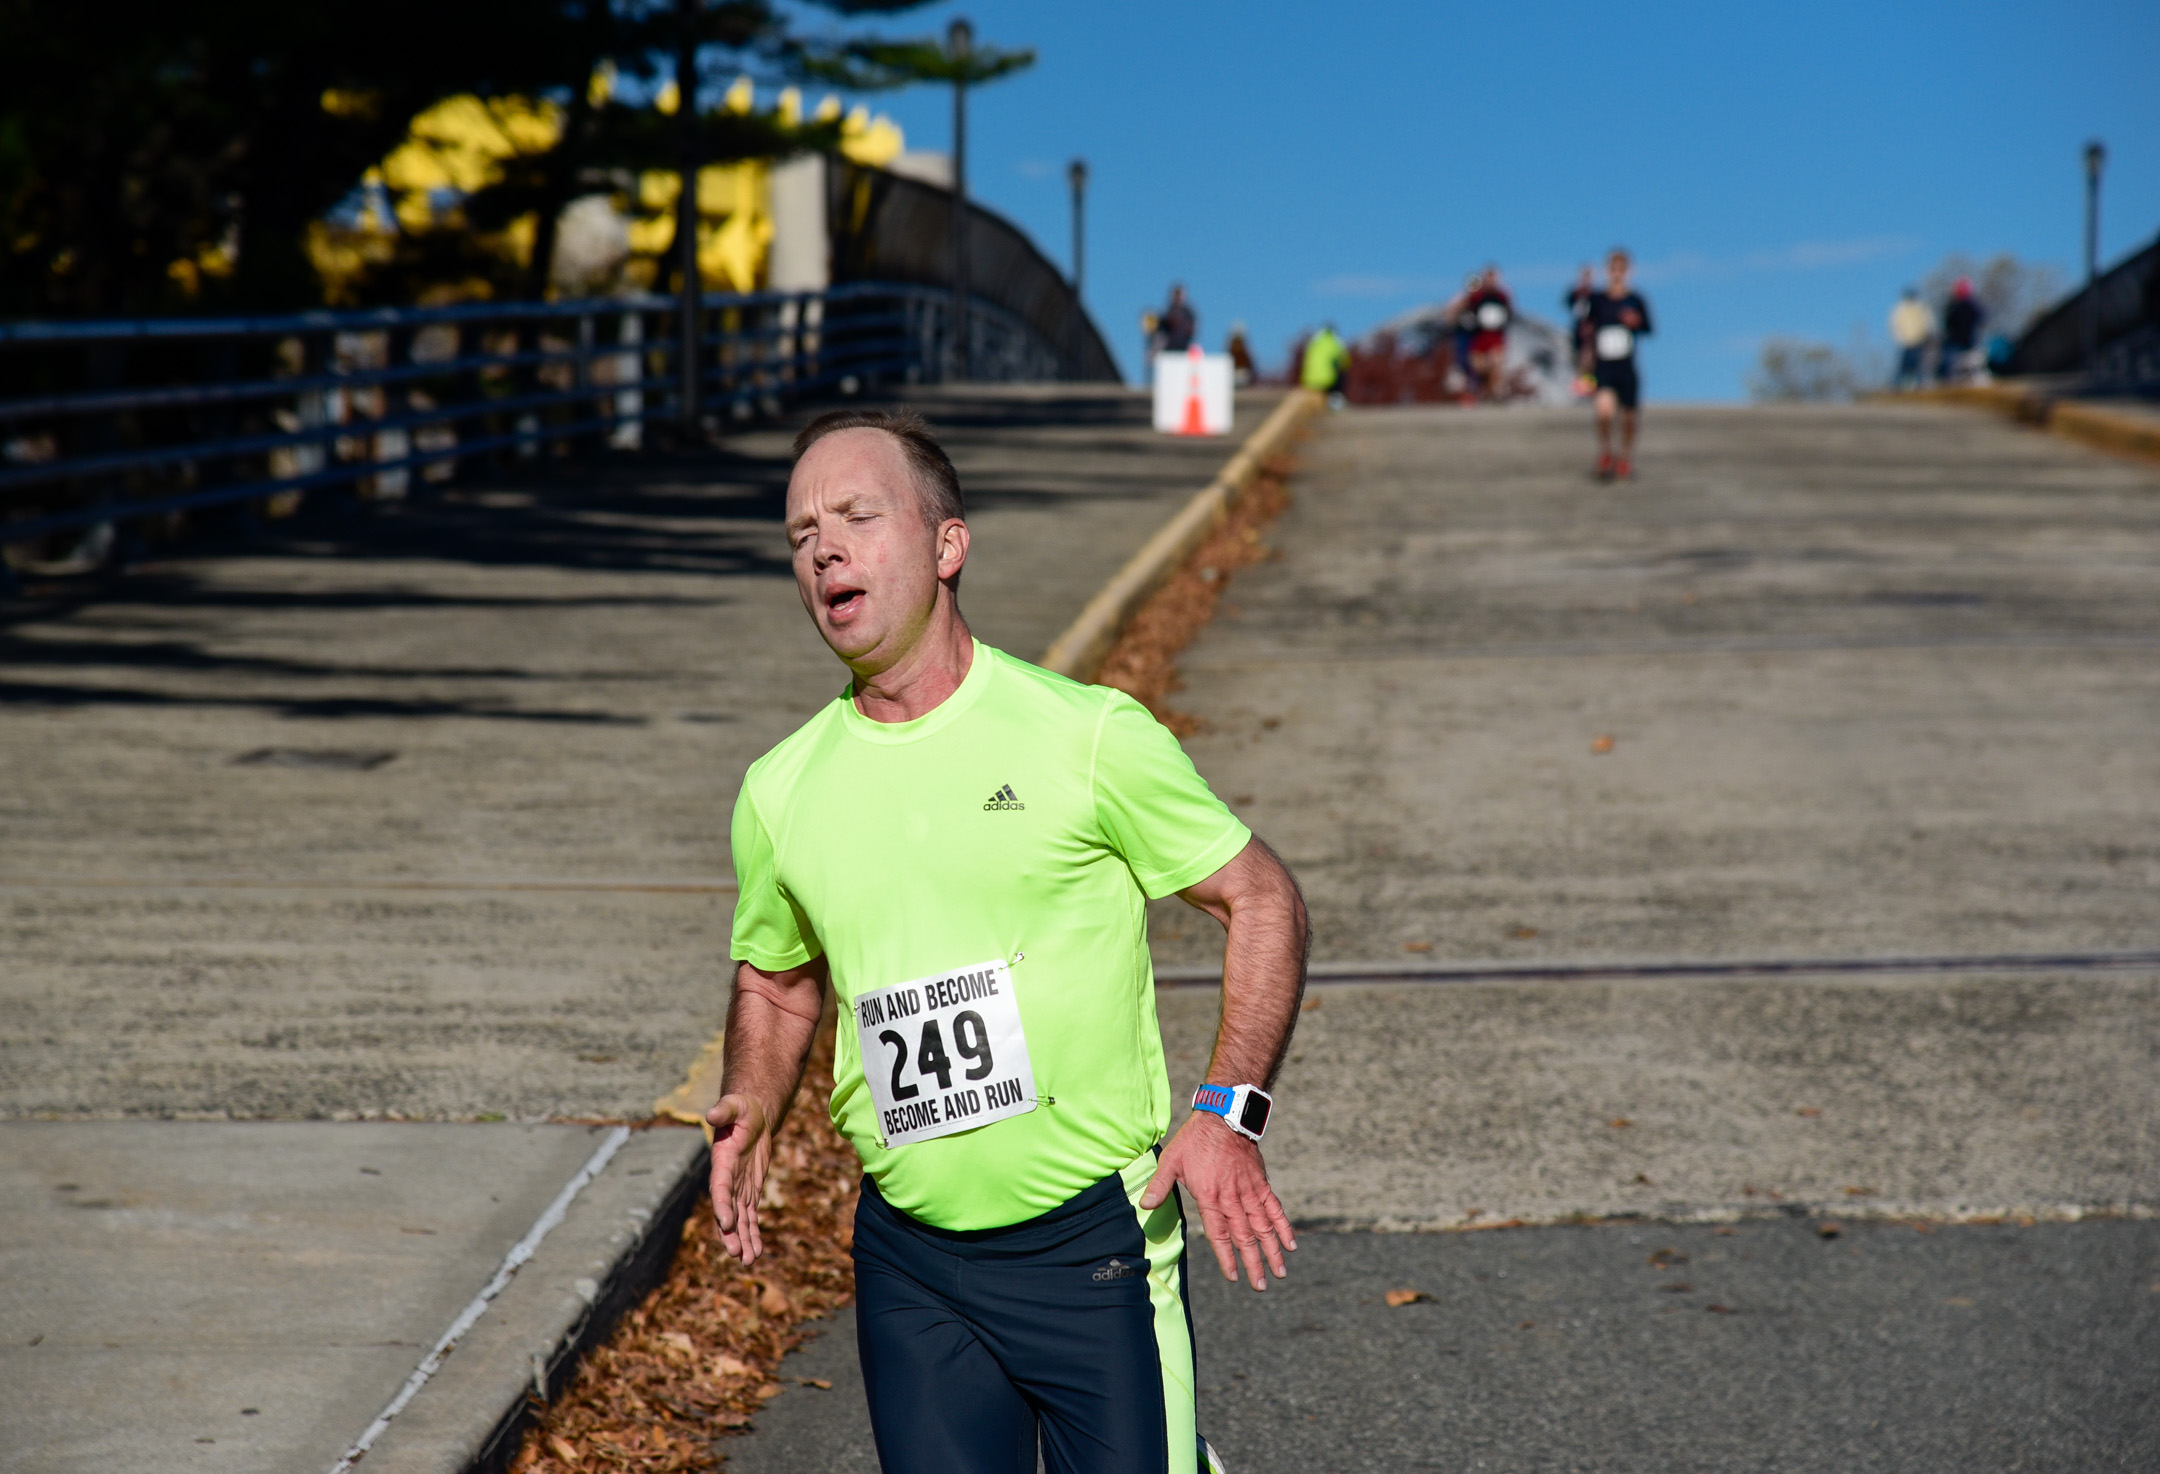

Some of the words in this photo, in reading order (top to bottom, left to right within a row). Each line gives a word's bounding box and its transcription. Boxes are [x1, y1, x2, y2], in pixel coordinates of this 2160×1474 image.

[983, 800, 1025, 811] adidas
[861, 997, 885, 1028] RUN
[887, 988, 921, 1021] AND
[924, 968, 999, 1011] BECOME
[878, 1009, 994, 1102] 249
[883, 1098, 941, 1136] BECOME
[943, 1089, 981, 1122] AND
[984, 1077, 1023, 1110] RUN
[1092, 1268, 1135, 1281] adidas
